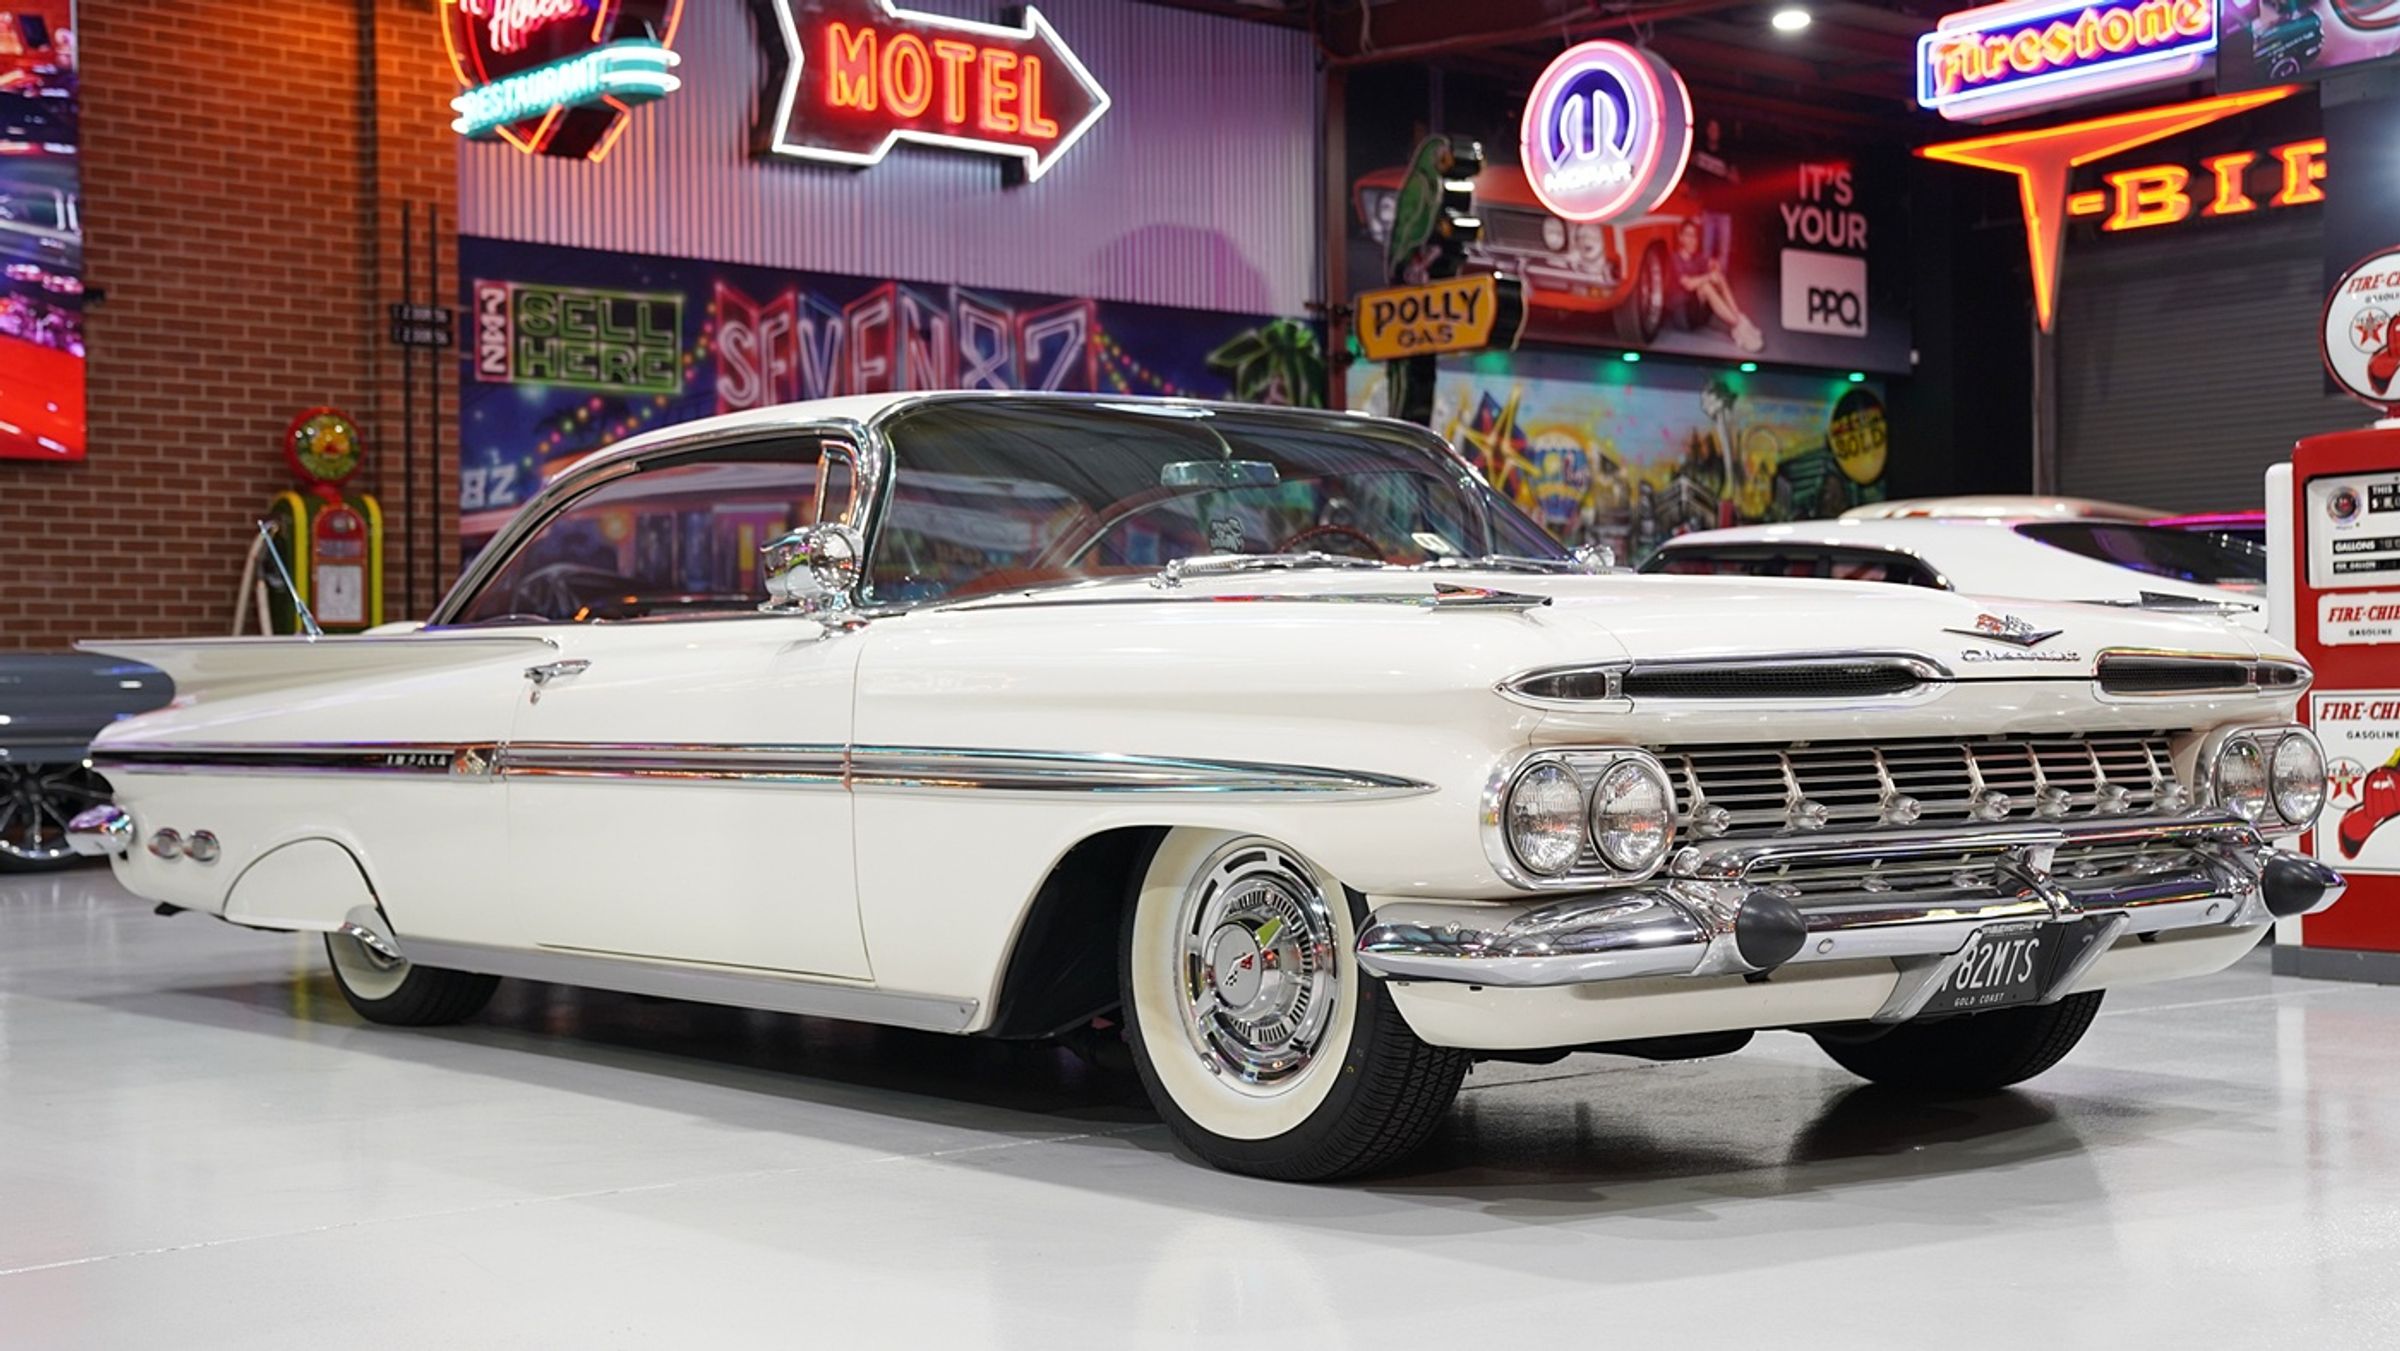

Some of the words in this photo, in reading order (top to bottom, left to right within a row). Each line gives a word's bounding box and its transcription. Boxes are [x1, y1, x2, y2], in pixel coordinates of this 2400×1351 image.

[1929, 0, 2209, 97] Firestone
[464, 54, 600, 126] RESTAURANT
[826, 22, 1058, 139] MOTEL
[1544, 161, 1633, 192] MOPAR
[1799, 164, 1854, 206] IT'S
[1780, 202, 1867, 249] YOUR
[519, 289, 673, 344] SELL
[1373, 285, 1481, 337] POLLY
[1808, 287, 1862, 328] PPQ
[1398, 324, 1454, 347] GAS
[519, 335, 673, 387] HERE
[1836, 427, 1884, 459] SOLD
[2335, 540, 2376, 552] GALLONS
[2348, 629, 2392, 637] GASOLINE
[2346, 730, 2400, 740] GASOLINE
[386, 755, 448, 767] IMPALA
[1954, 996, 1975, 1007] GOLD
[1980, 992, 2005, 1004] COAST
